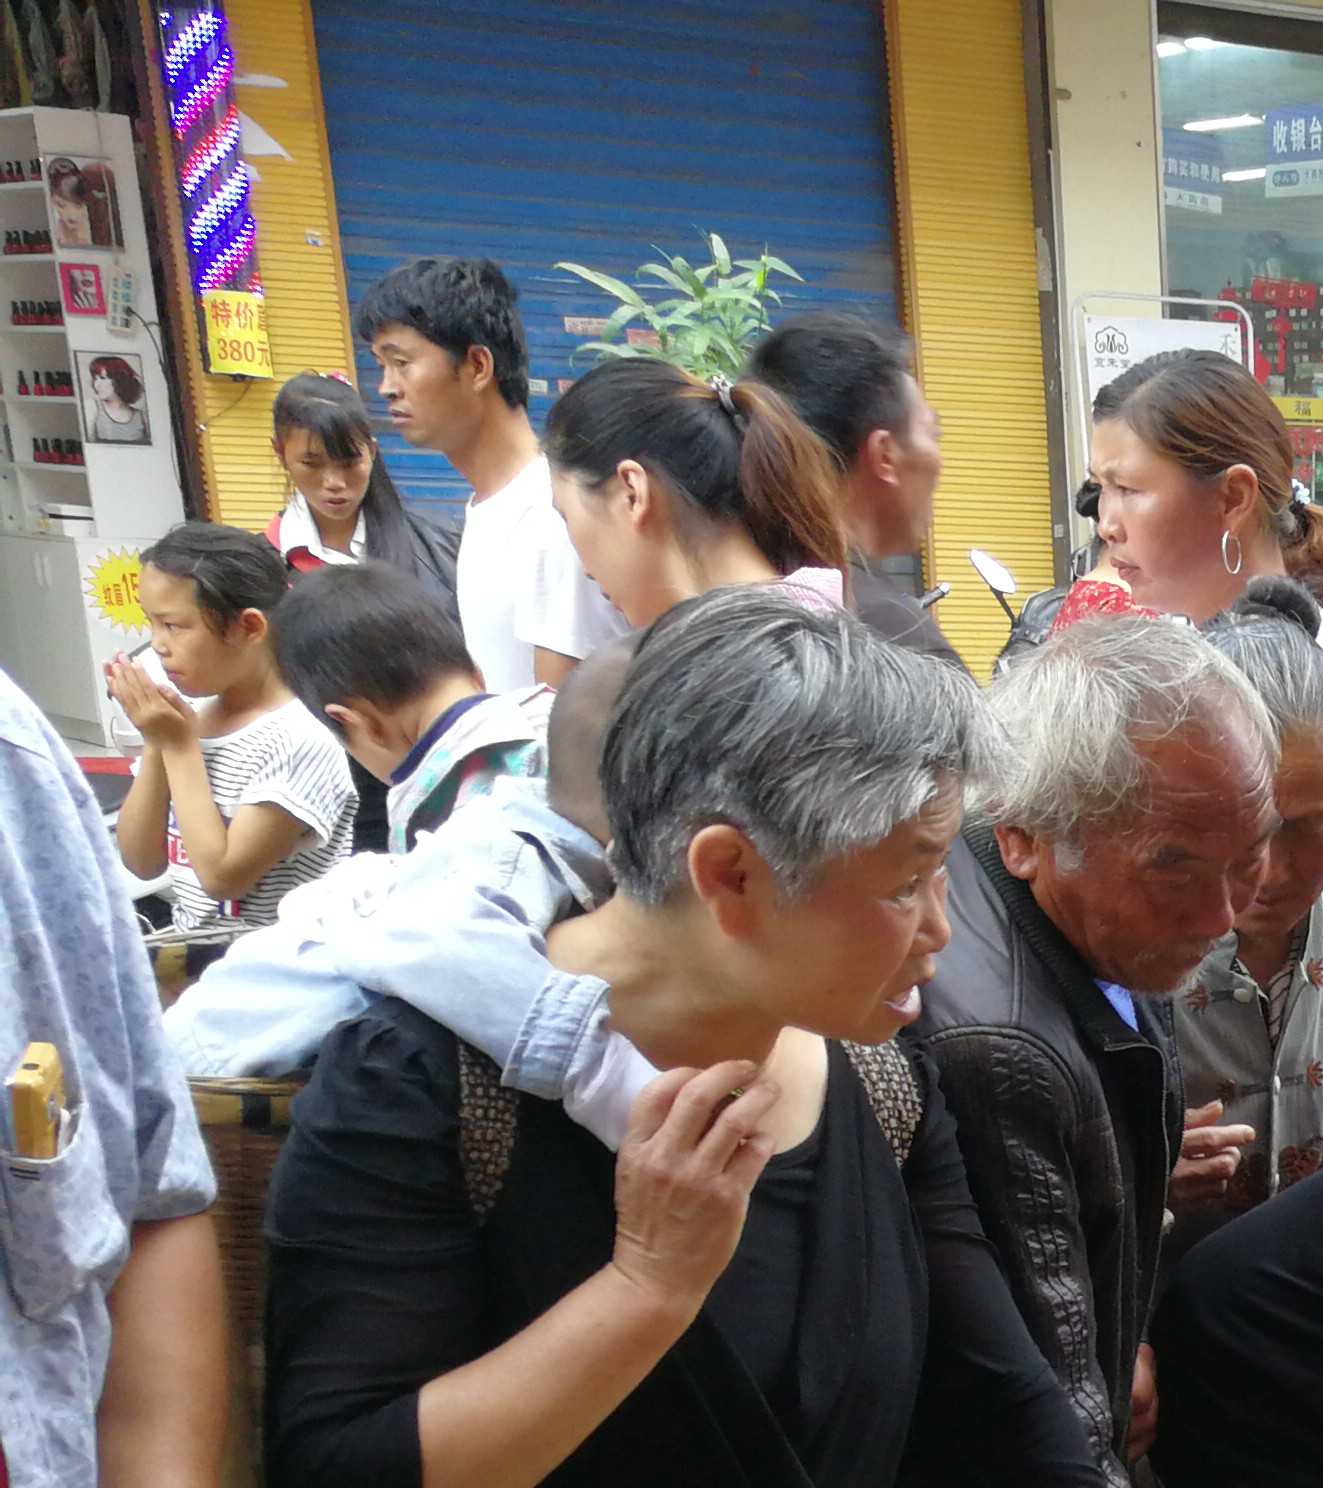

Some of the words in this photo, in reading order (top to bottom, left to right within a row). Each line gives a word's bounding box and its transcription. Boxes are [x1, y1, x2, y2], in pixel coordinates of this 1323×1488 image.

[1272, 115, 1323, 153] 收银台
[1163, 157, 1221, 184] 购买和使用
[217, 338, 270, 367] 380元
